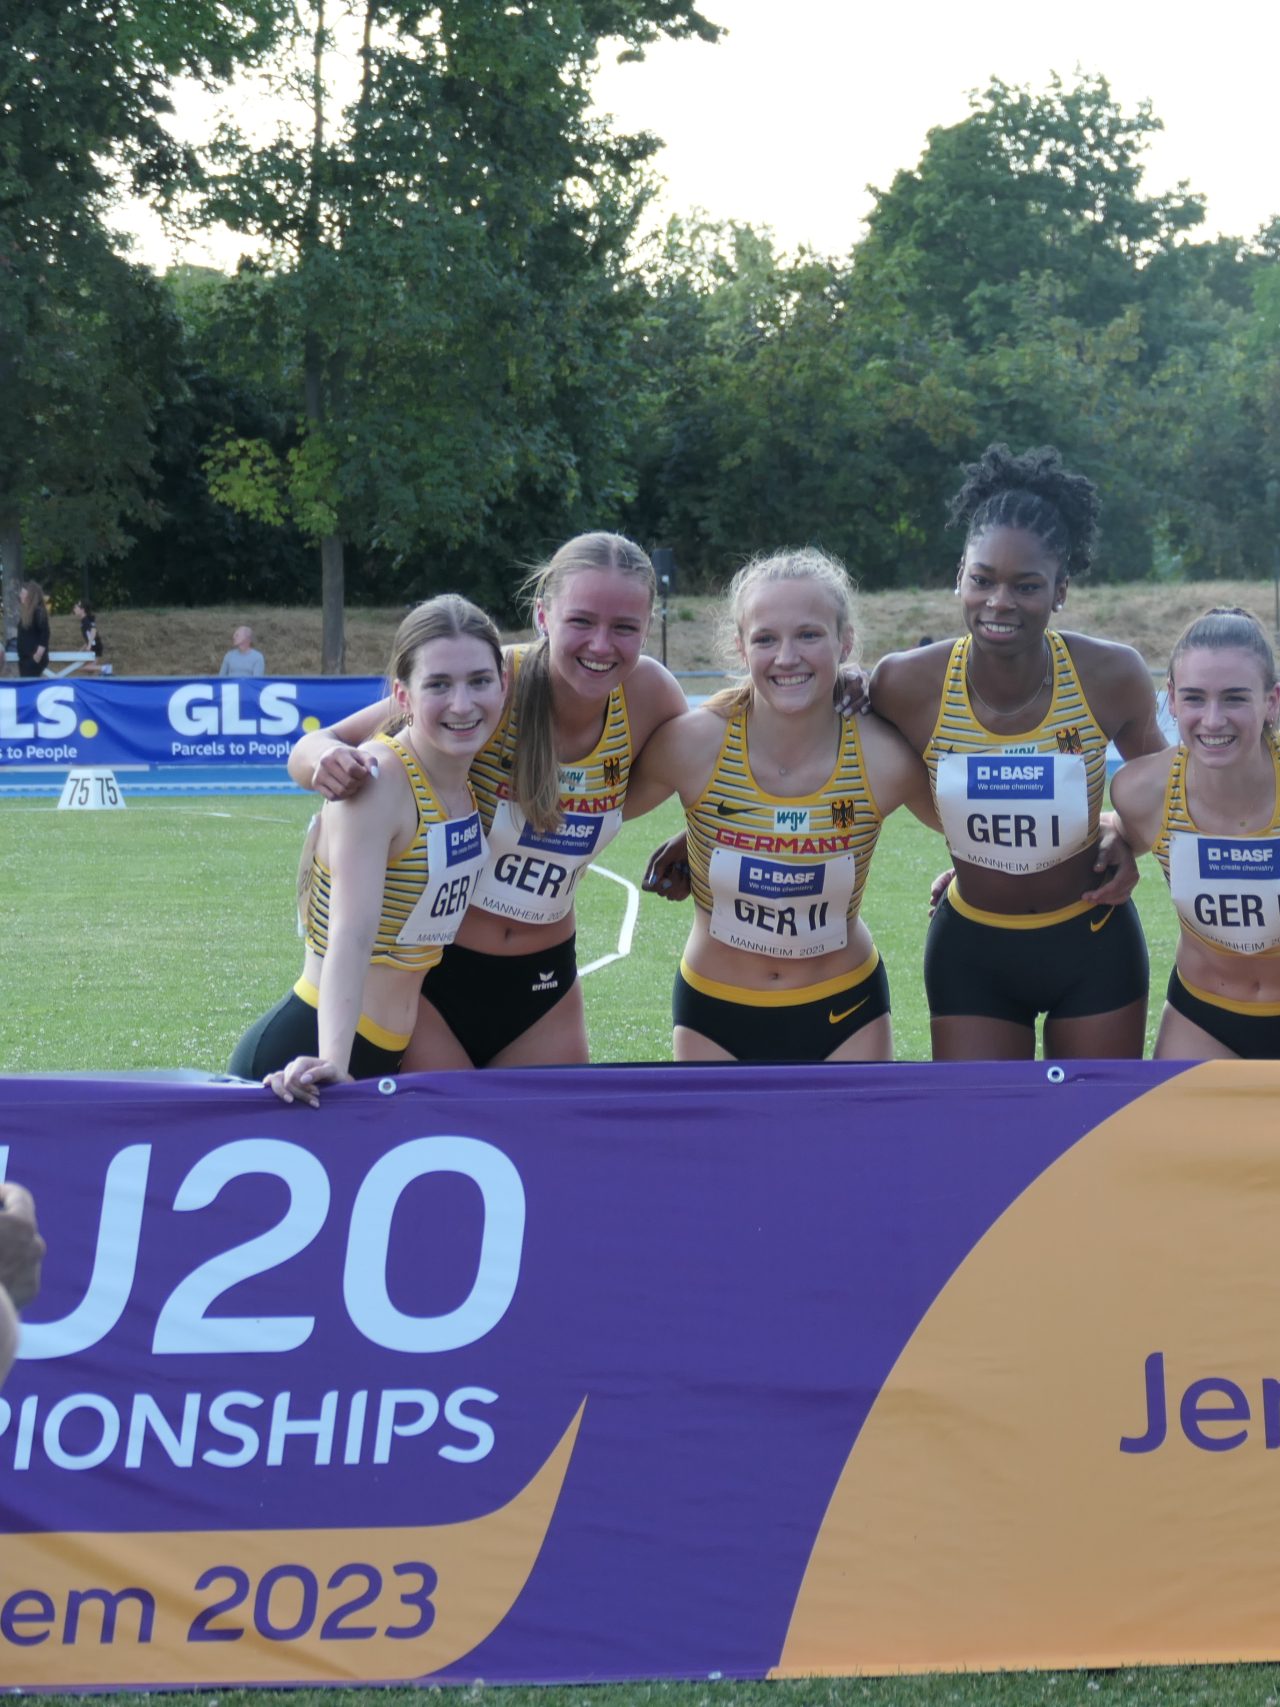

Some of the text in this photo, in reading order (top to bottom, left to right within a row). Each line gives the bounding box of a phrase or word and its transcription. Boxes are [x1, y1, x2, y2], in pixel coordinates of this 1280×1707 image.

[7, 747, 23, 759] to
[26, 745, 77, 762] People
[172, 740, 295, 758] Parcels to Peopl
[1000, 766, 1044, 780] BASF
[68, 777, 118, 806] 75 75
[1011, 783, 1044, 792] chemistry
[967, 813, 1060, 848] GER I
[715, 828, 853, 855] GERMANY
[967, 853, 1029, 872] MANNHEIM
[1231, 848, 1273, 862] BASF
[493, 852, 568, 899] GER
[772, 872, 815, 885] BASF
[1242, 864, 1274, 872] chemistry
[430, 875, 470, 918] GER
[749, 881, 814, 894] We create chemistry
[482, 896, 545, 921] MANNHEIM
[734, 898, 829, 937] GER II
[1194, 893, 1265, 927] GER
[416, 932, 457, 942] MANNHE
[730, 935, 825, 956] MANNHEIM 2023
[531, 980, 558, 992] erima
[0, 1135, 526, 1360] U20
[0, 1386, 499, 1471] IONSHIPS
[187, 1561, 438, 1643] 2023
